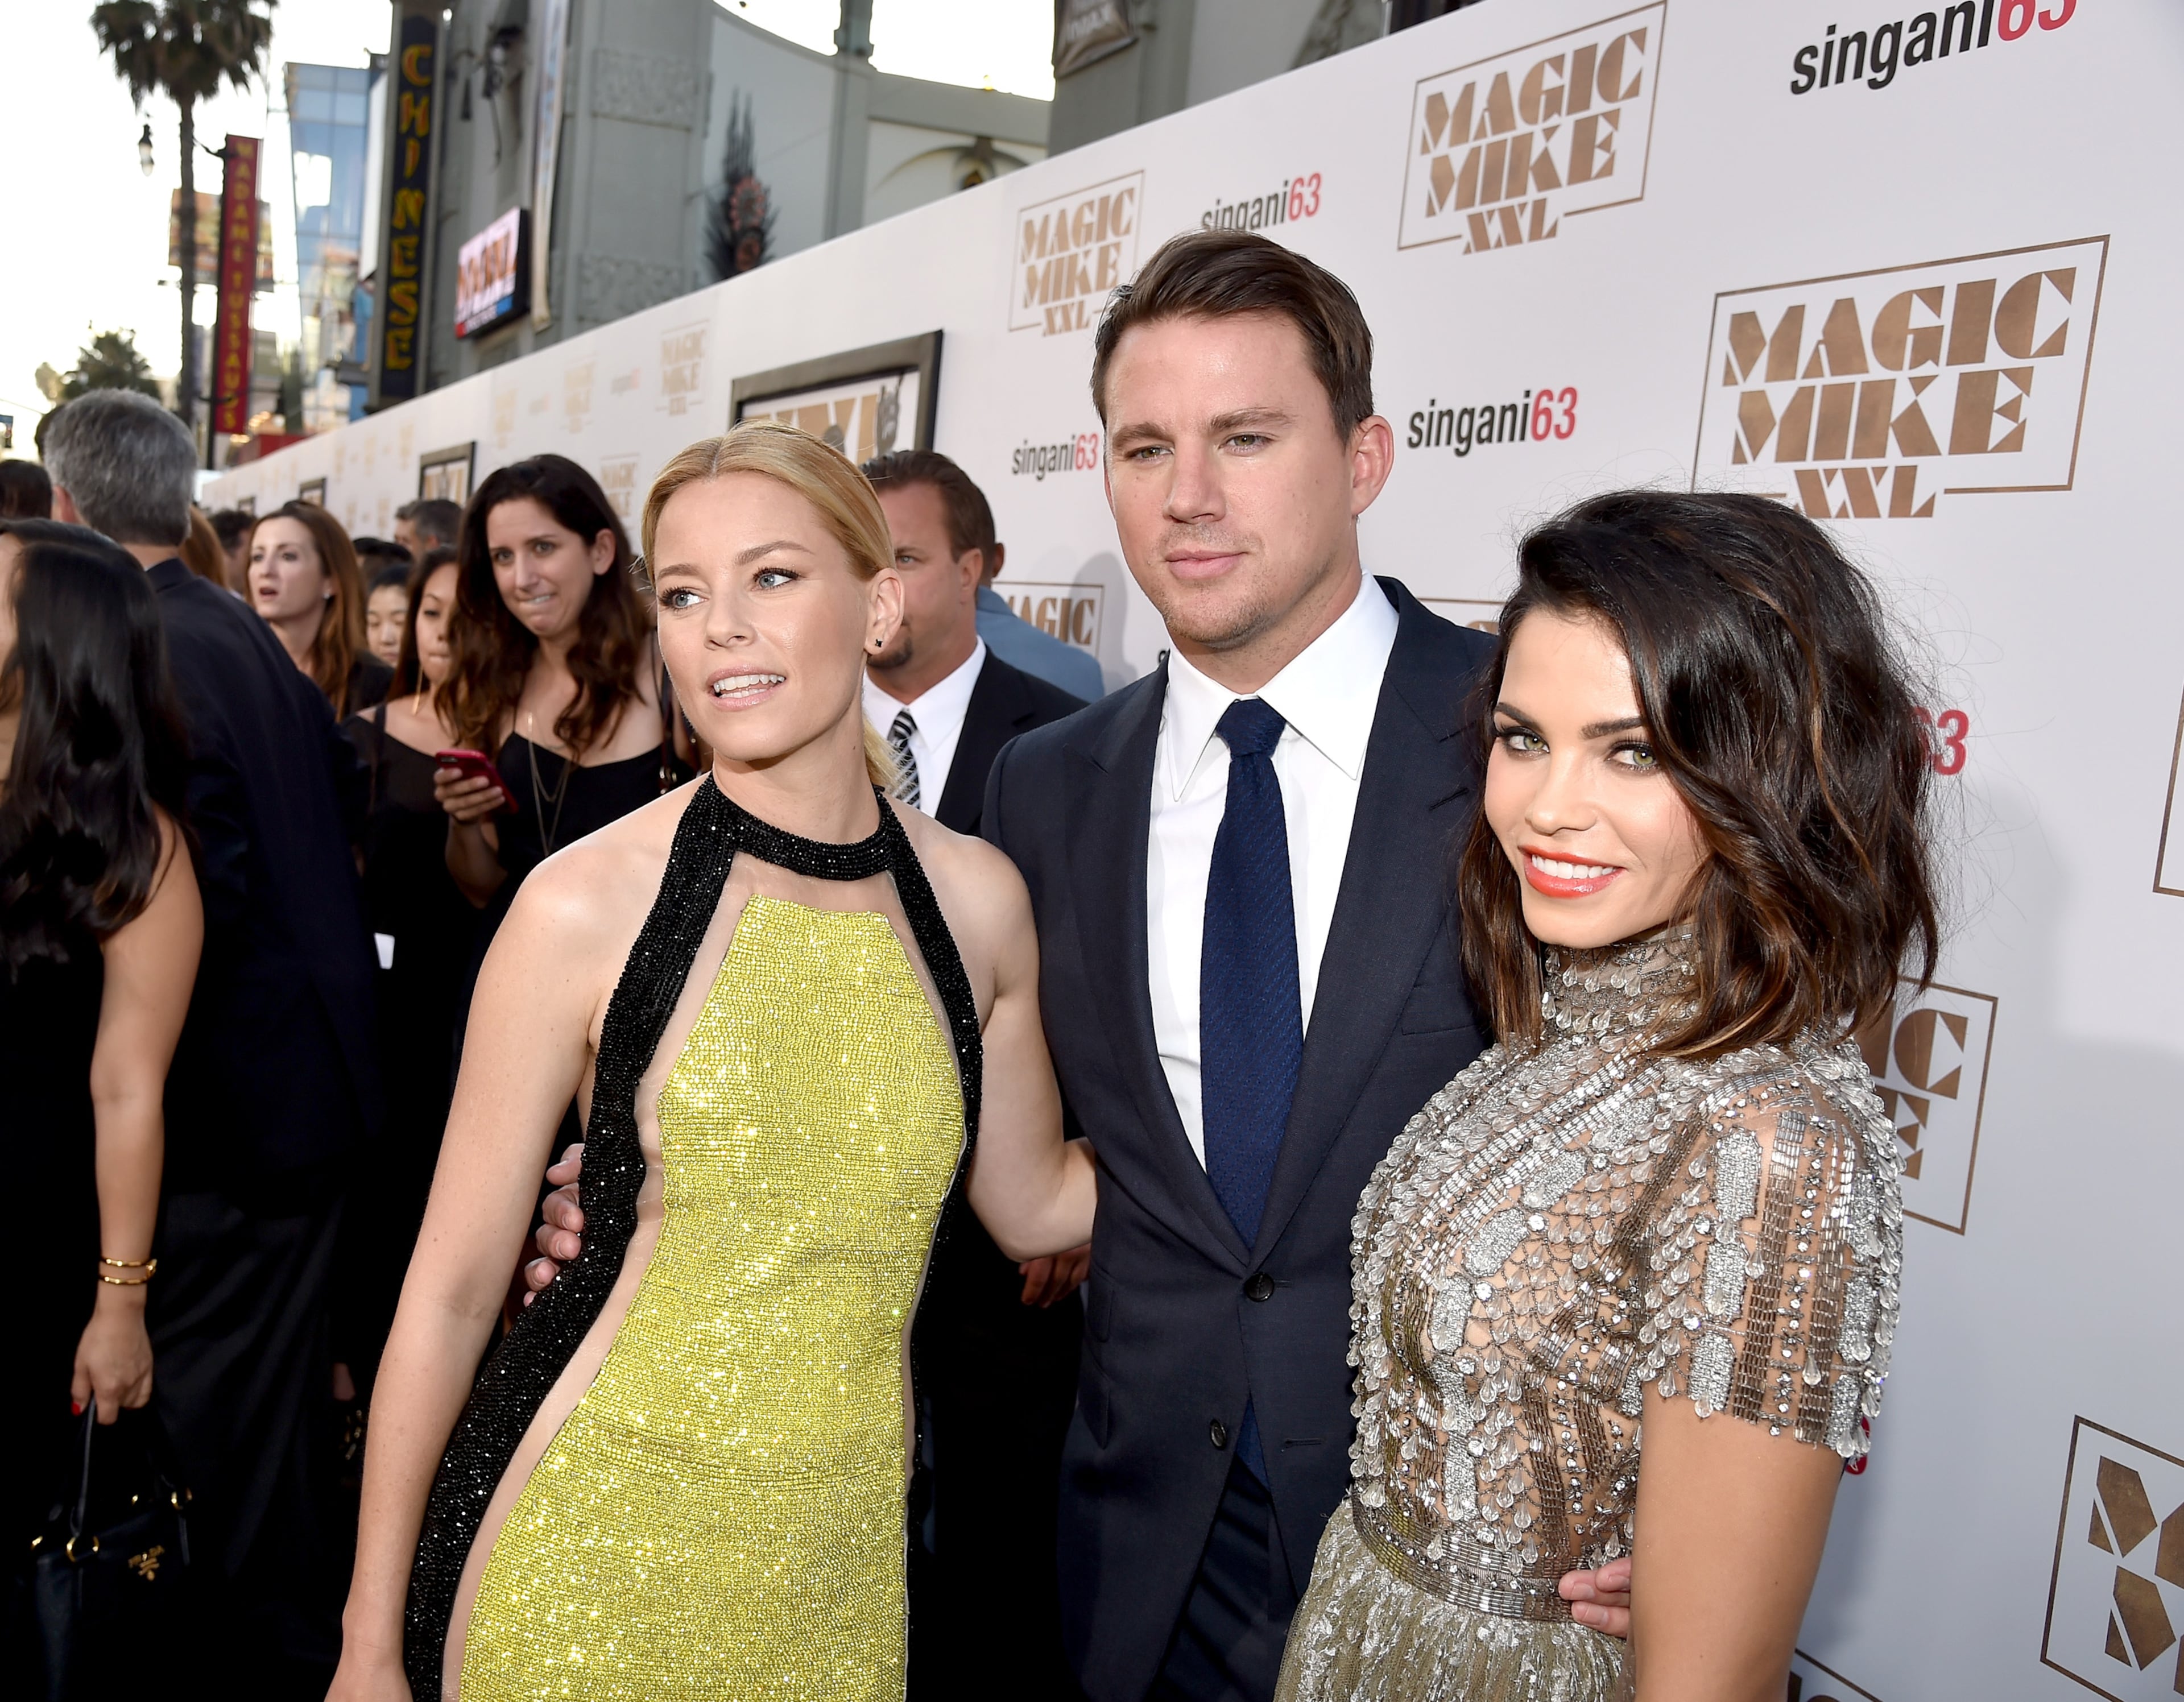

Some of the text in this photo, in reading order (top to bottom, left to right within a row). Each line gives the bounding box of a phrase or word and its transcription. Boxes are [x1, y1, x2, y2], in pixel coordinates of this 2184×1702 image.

[1420, 27, 1647, 155] MAGIC
[1425, 108, 1620, 218] MIKE
[386, 44, 432, 368] CHINESE
[1021, 188, 1135, 264] MAGIC
[1462, 198, 1559, 255] XXL
[1023, 242, 1121, 309] MIKE
[1043, 300, 1090, 337] XXL
[1722, 267, 2077, 387] MAGIC
[1407, 387, 1578, 457] singani63
[1732, 366, 2034, 465] MIKE
[1012, 433, 1098, 481] singani63
[1792, 465, 1936, 519] XXL
[1008, 597, 1095, 646] AGIC
